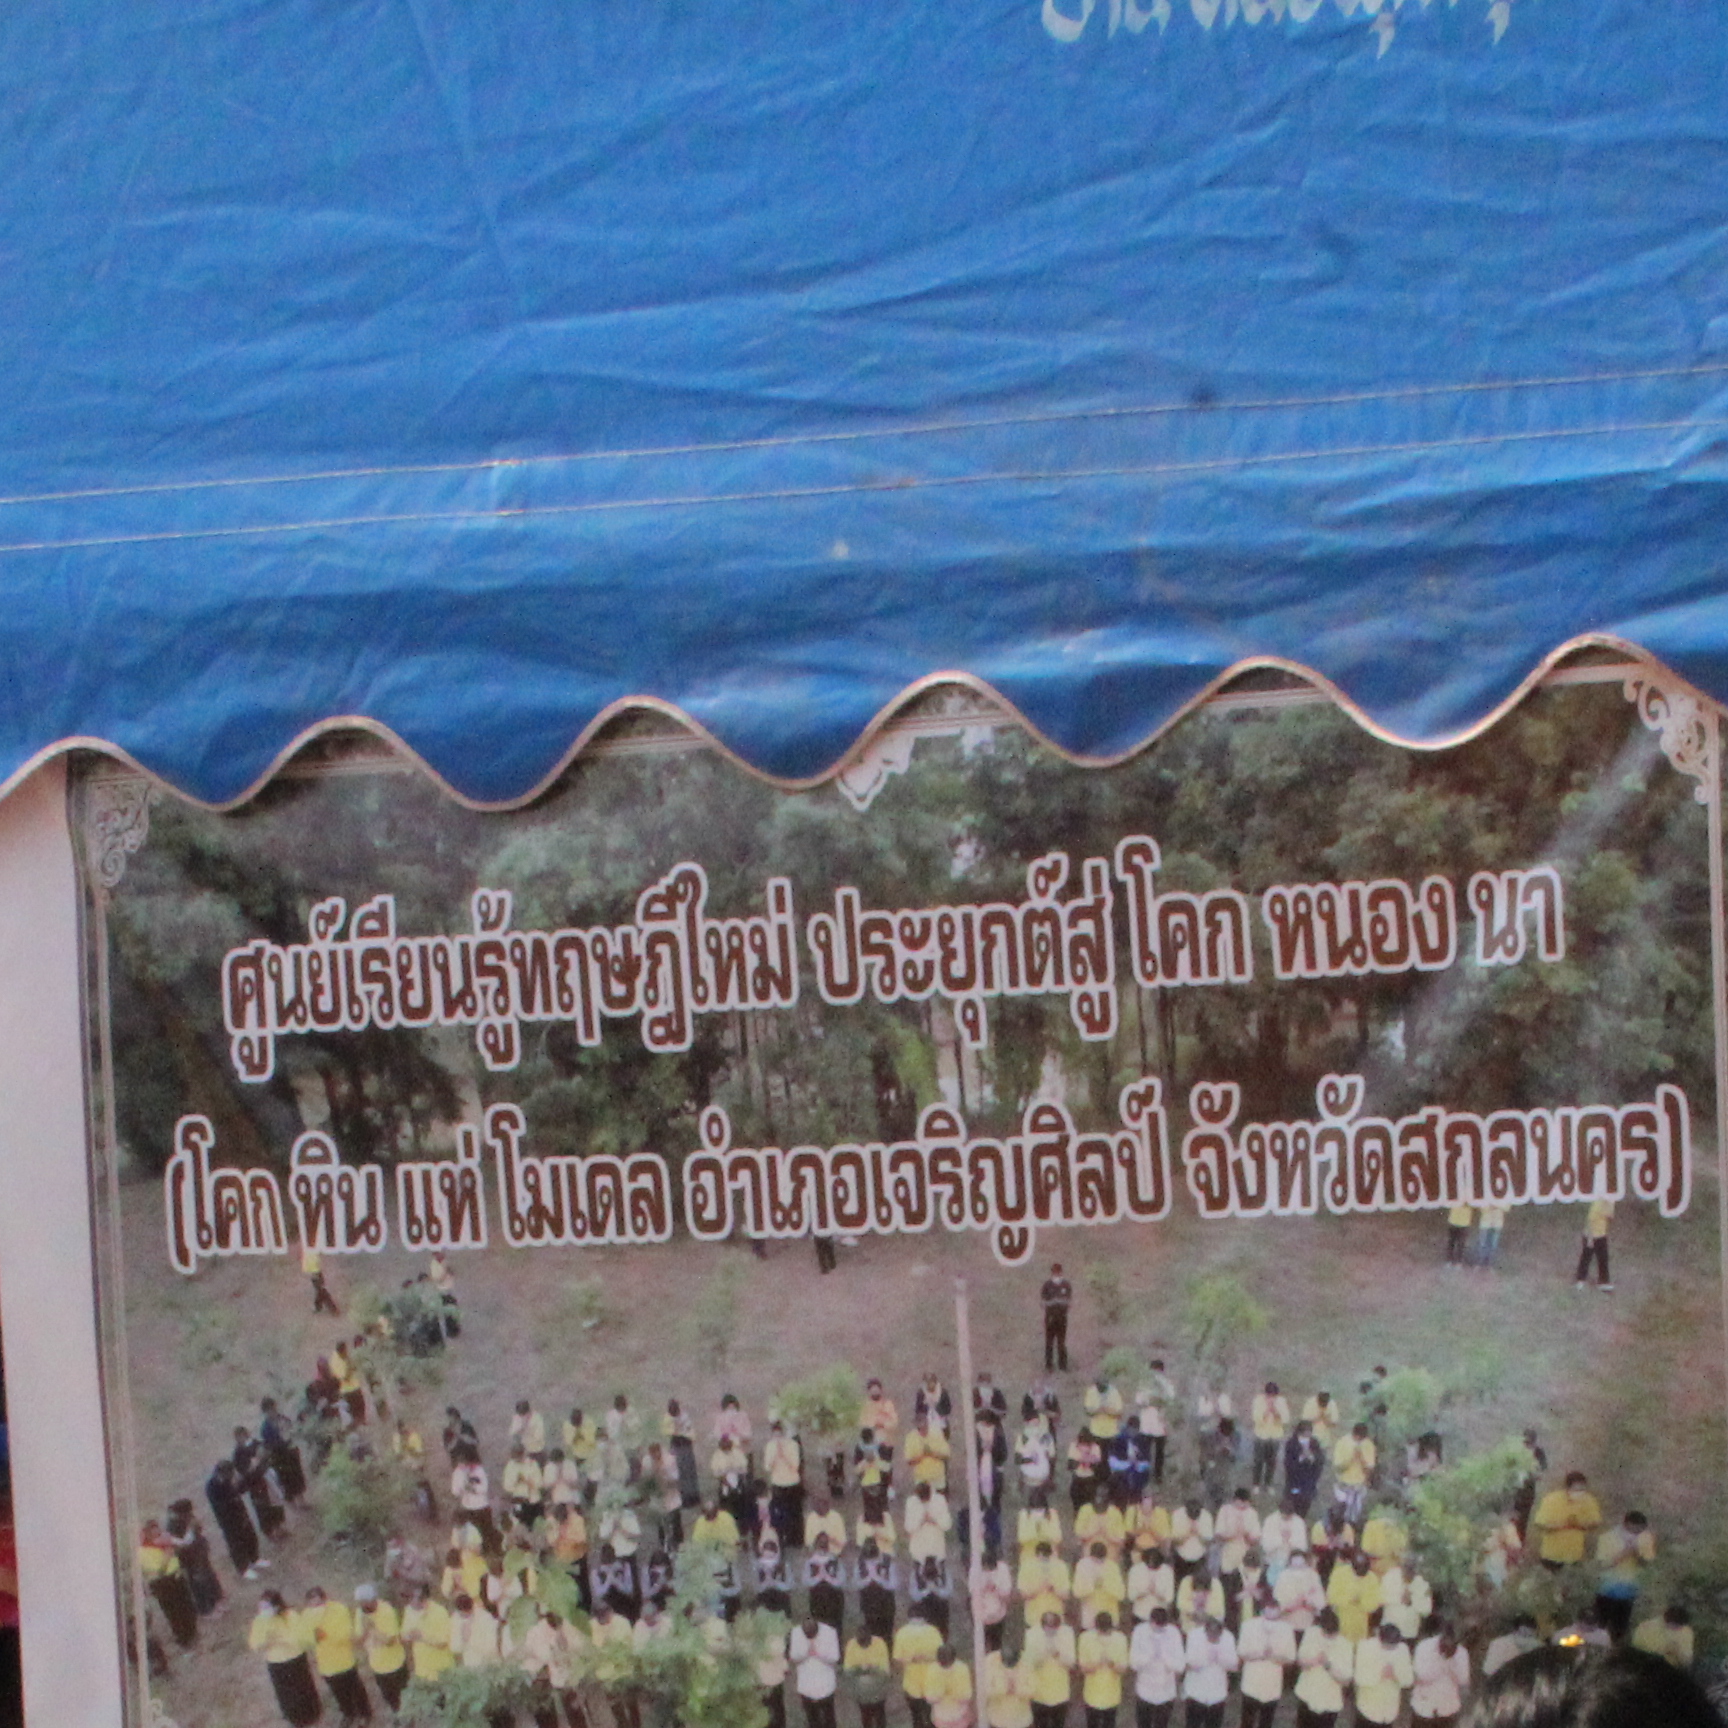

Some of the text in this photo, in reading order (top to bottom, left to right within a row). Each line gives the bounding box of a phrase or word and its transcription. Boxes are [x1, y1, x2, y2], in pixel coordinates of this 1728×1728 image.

[222, 834, 1564, 1082] ศูนย์เรียนรู้ทฤษฎีใหม่ ประยุกต์สู่ โคก หนอง นา
[164, 1073, 1692, 1275] (โคก หิน แห่ โมเดล อำเภอเจริญศิลป์ จังหวัดสกลนคร)
